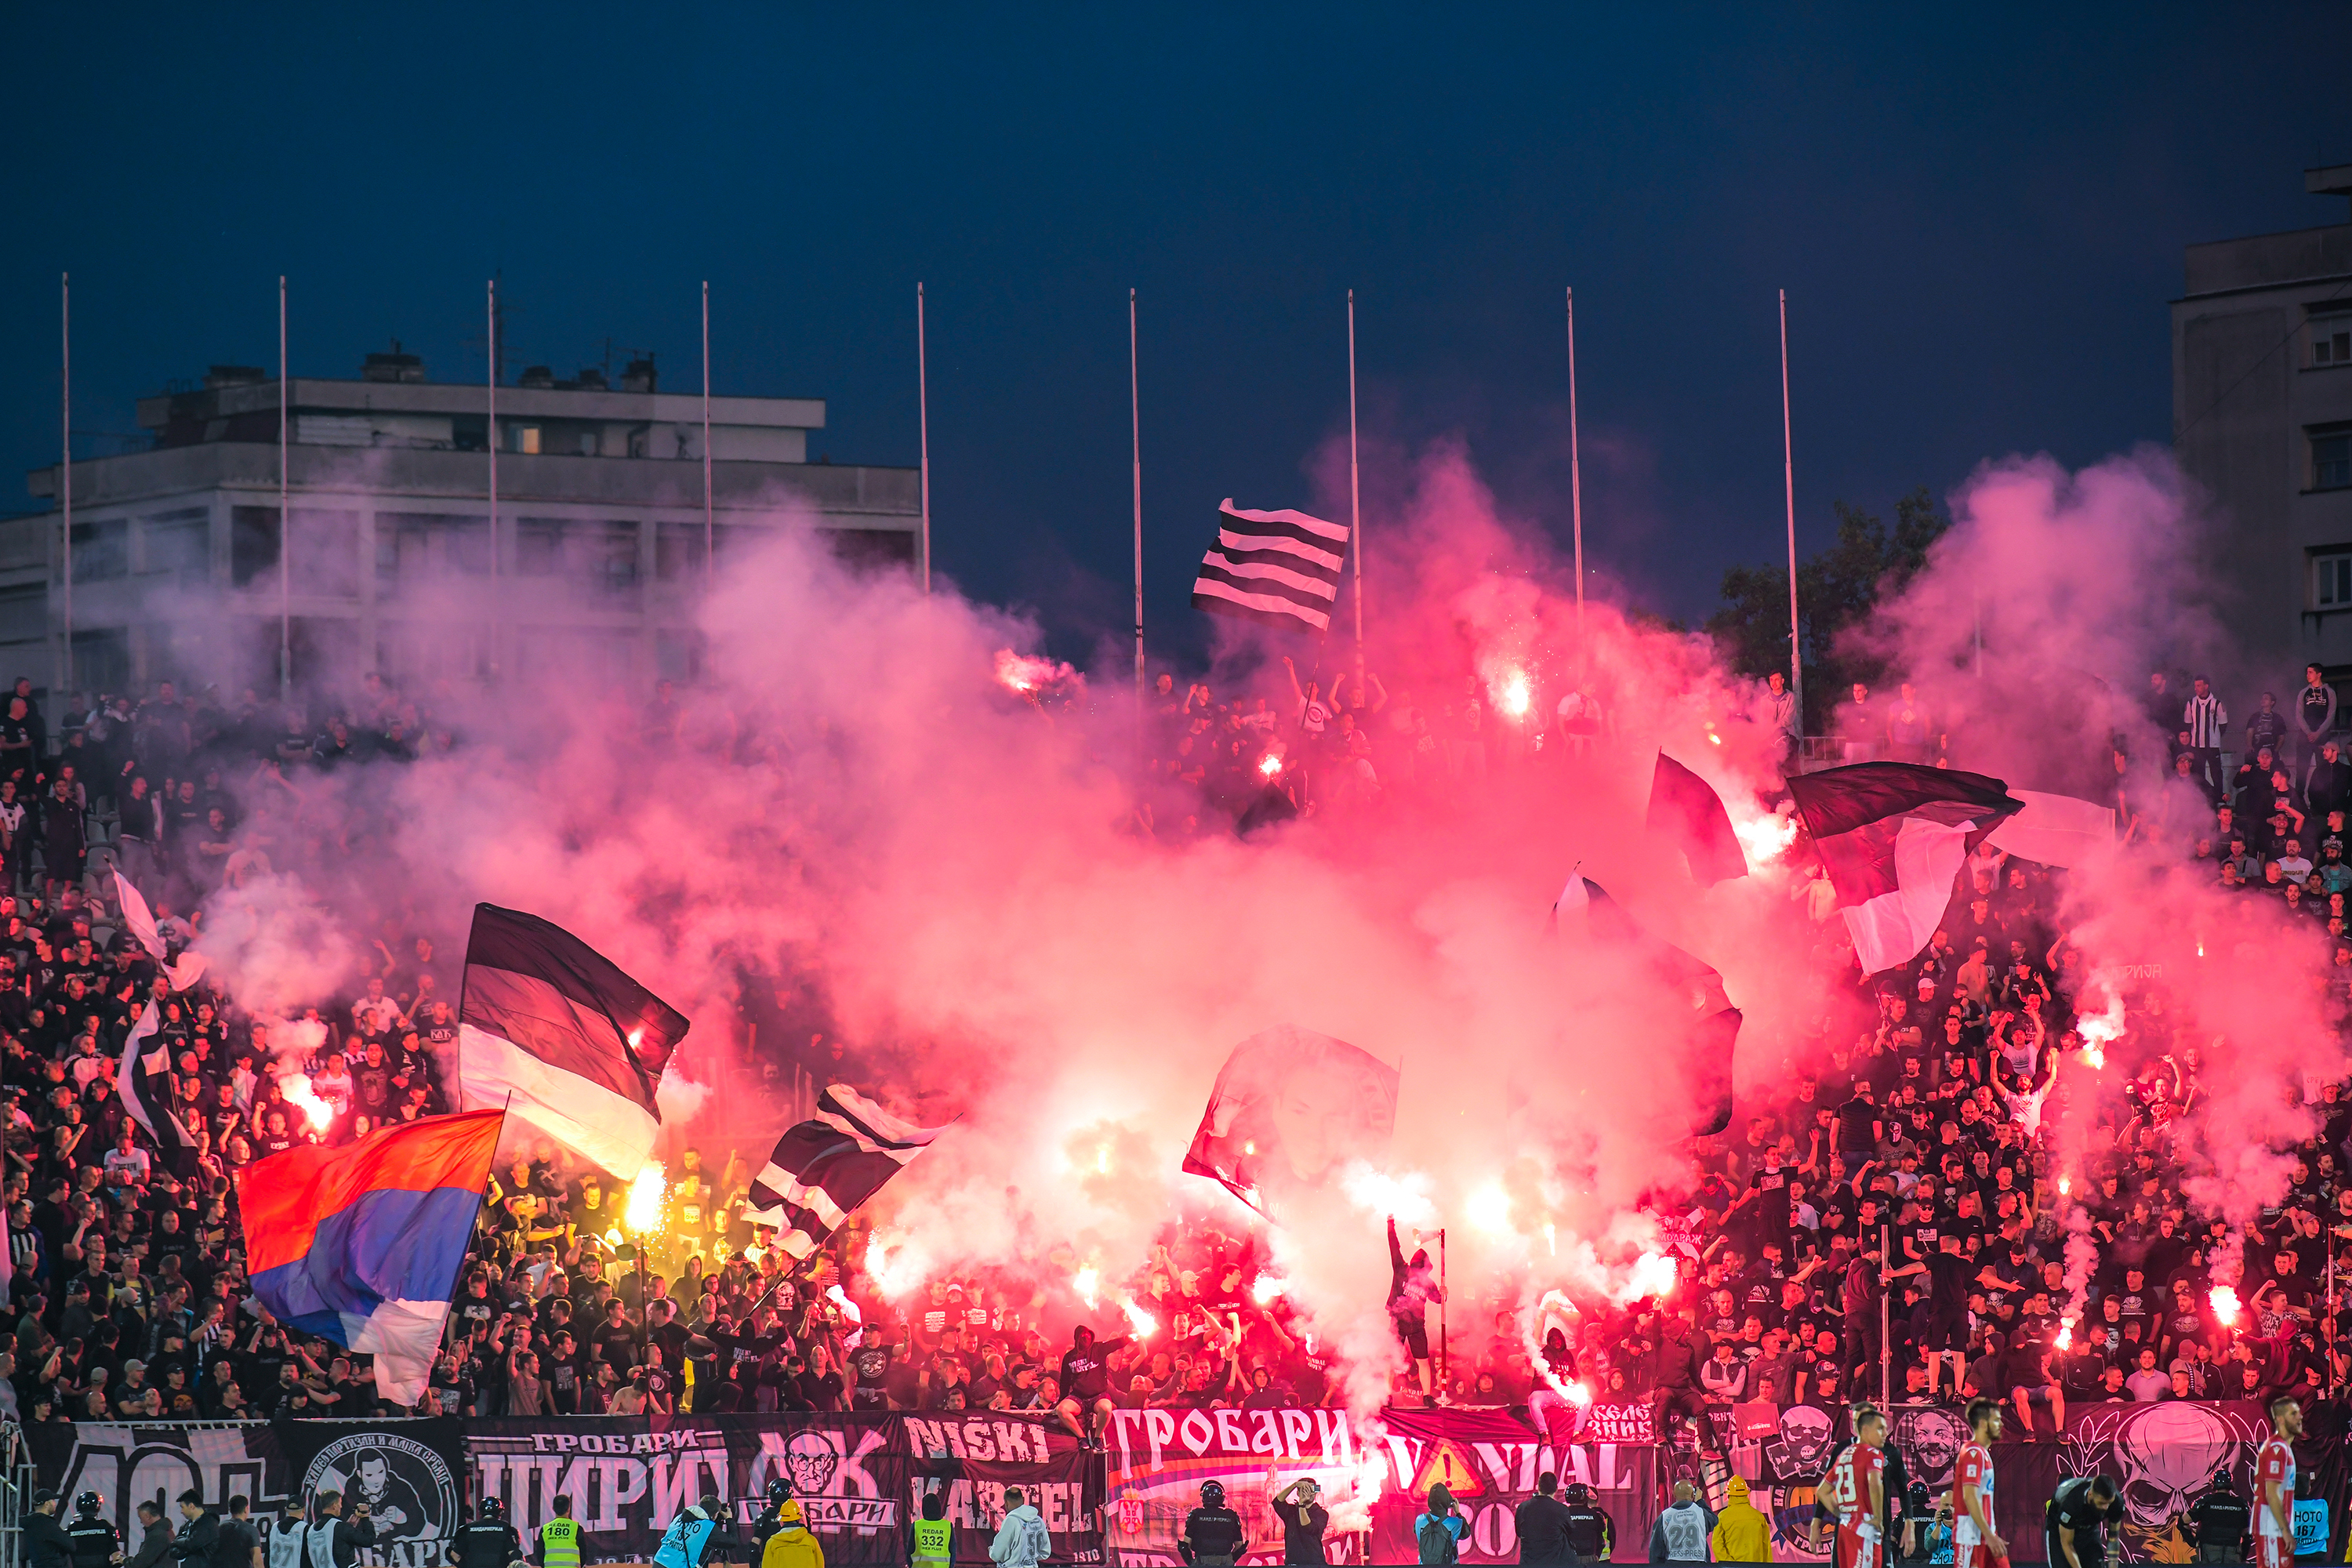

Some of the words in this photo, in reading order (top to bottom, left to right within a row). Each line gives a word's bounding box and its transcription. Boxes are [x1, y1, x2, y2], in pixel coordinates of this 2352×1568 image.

[532, 1429, 699, 1454] ГРОБАРИ
[903, 1416, 1050, 1464] NIŠKI
[1112, 1409, 1353, 1479] ГРОБАРИ
[1835, 1464, 1857, 1504] 23
[746, 1502, 886, 1523] ГБАРИ
[2295, 1512, 2322, 1523] HOTO
[547, 1527, 570, 1537] 180
[921, 1536, 944, 1547] 332
[1669, 1524, 1699, 1549] 29
[2296, 1526, 2316, 1537] 167
[1073, 1548, 1100, 1563] 1970
